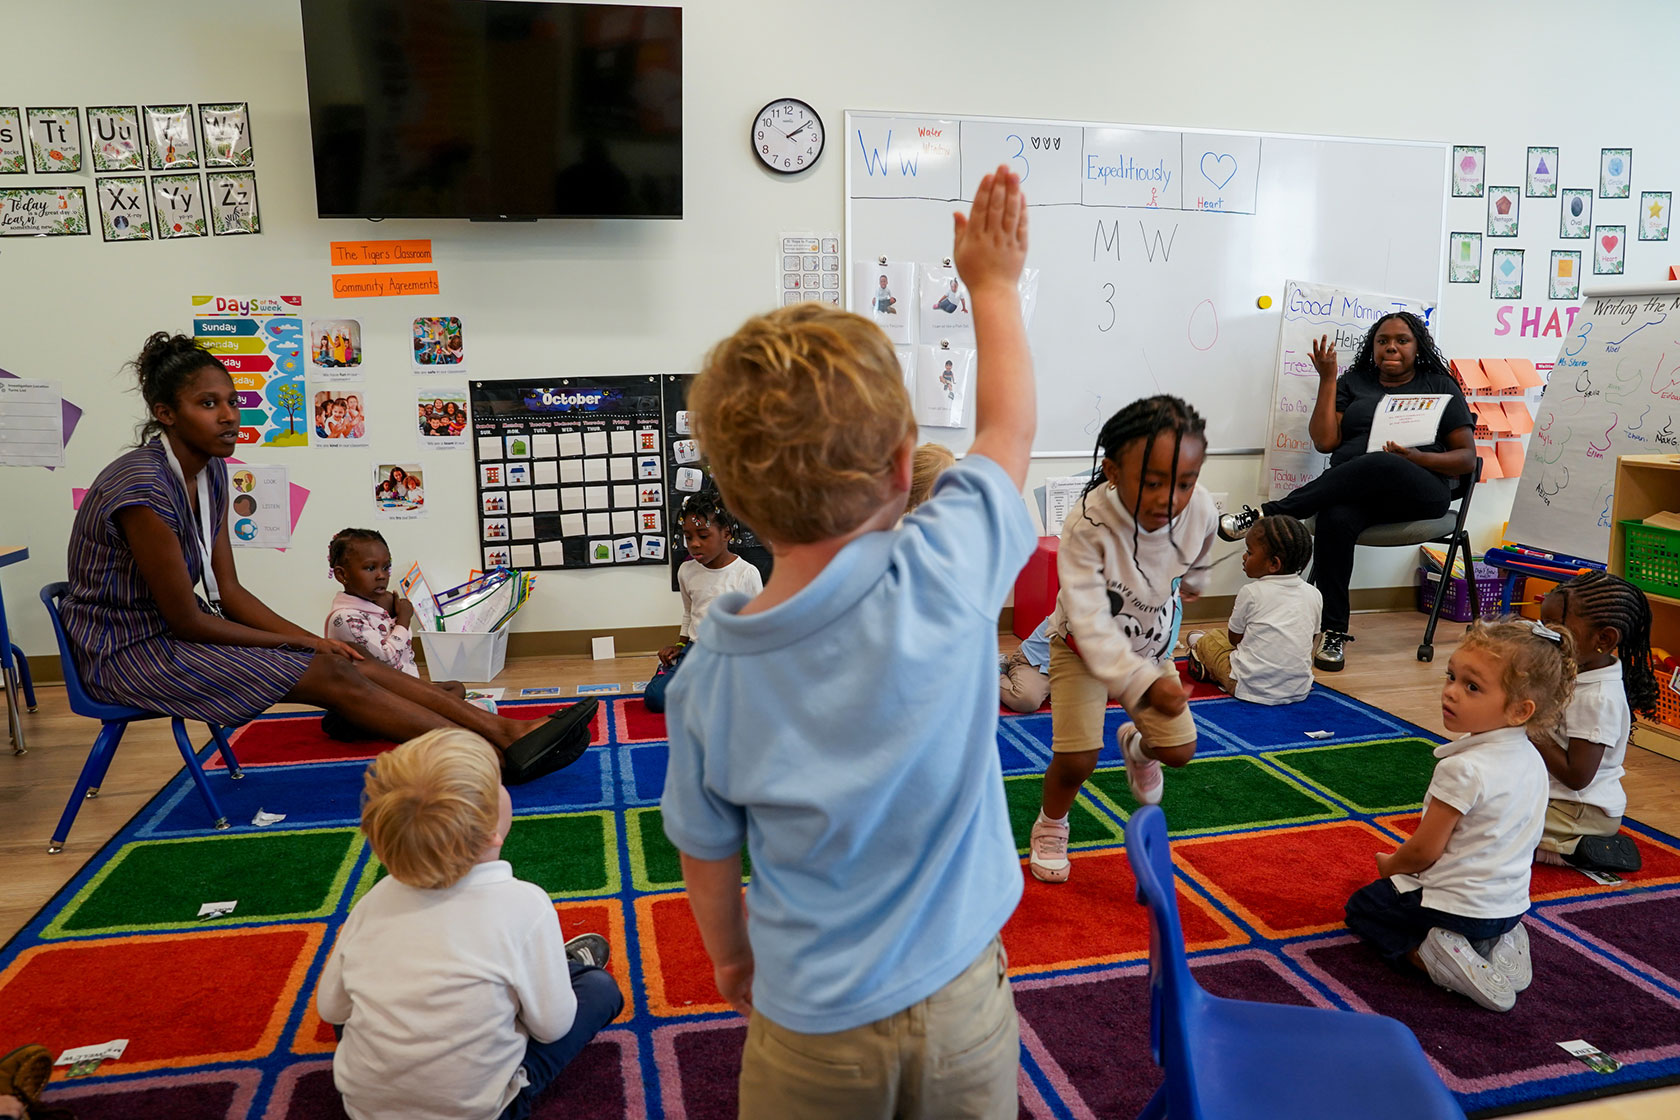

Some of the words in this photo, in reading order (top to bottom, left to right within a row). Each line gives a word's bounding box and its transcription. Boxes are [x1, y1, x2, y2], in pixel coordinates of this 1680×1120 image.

[771, 109, 780, 118] 11
[783, 105, 794, 115] 12
[799, 110, 803, 119] 1
[96, 117, 131, 141] Uu
[762, 118, 772, 127] 10
[807, 120, 814, 129] 2
[39, 120, 67, 143] Tt
[757, 131, 764, 140] 9
[811, 133, 818, 142] 3
[917, 126, 943, 138] Water
[762, 145, 769, 154] 8
[806, 146, 813, 155] 4
[772, 155, 779, 164] 7
[784, 158, 791, 167] 6
[796, 155, 804, 165] 5
[1087, 154, 1171, 193] Expeditiously
[107, 188, 141, 211] Xx
[162, 187, 192, 213] Yy
[220, 183, 249, 206] Zz
[7, 197, 48, 217] Today
[1197, 197, 1224, 208] Heart
[1, 213, 36, 226] Learn
[1093, 219, 1121, 262] M
[1139, 220, 1179, 262] W
[336, 246, 358, 260] The
[361, 245, 390, 265] Tigers
[394, 245, 432, 260] Classroom
[335, 278, 383, 297] Community
[389, 277, 439, 295] Agreements
[216, 297, 259, 316] Days
[260, 304, 282, 312] week
[1098, 282, 1116, 332] 3
[1290, 288, 1334, 316] Good
[1594, 298, 1637, 325] Writing
[1643, 297, 1665, 313] the
[202, 323, 237, 333] Sunday
[1565, 322, 1593, 356] 3
[1284, 350, 1317, 375] Freez
[542, 392, 601, 406] October
[1280, 396, 1294, 412] Go
[1296, 399, 1308, 413] Go
[1271, 468, 1297, 482] Today
[1106, 579, 1134, 598] WAYS
[1131, 597, 1163, 613] TOGETH
